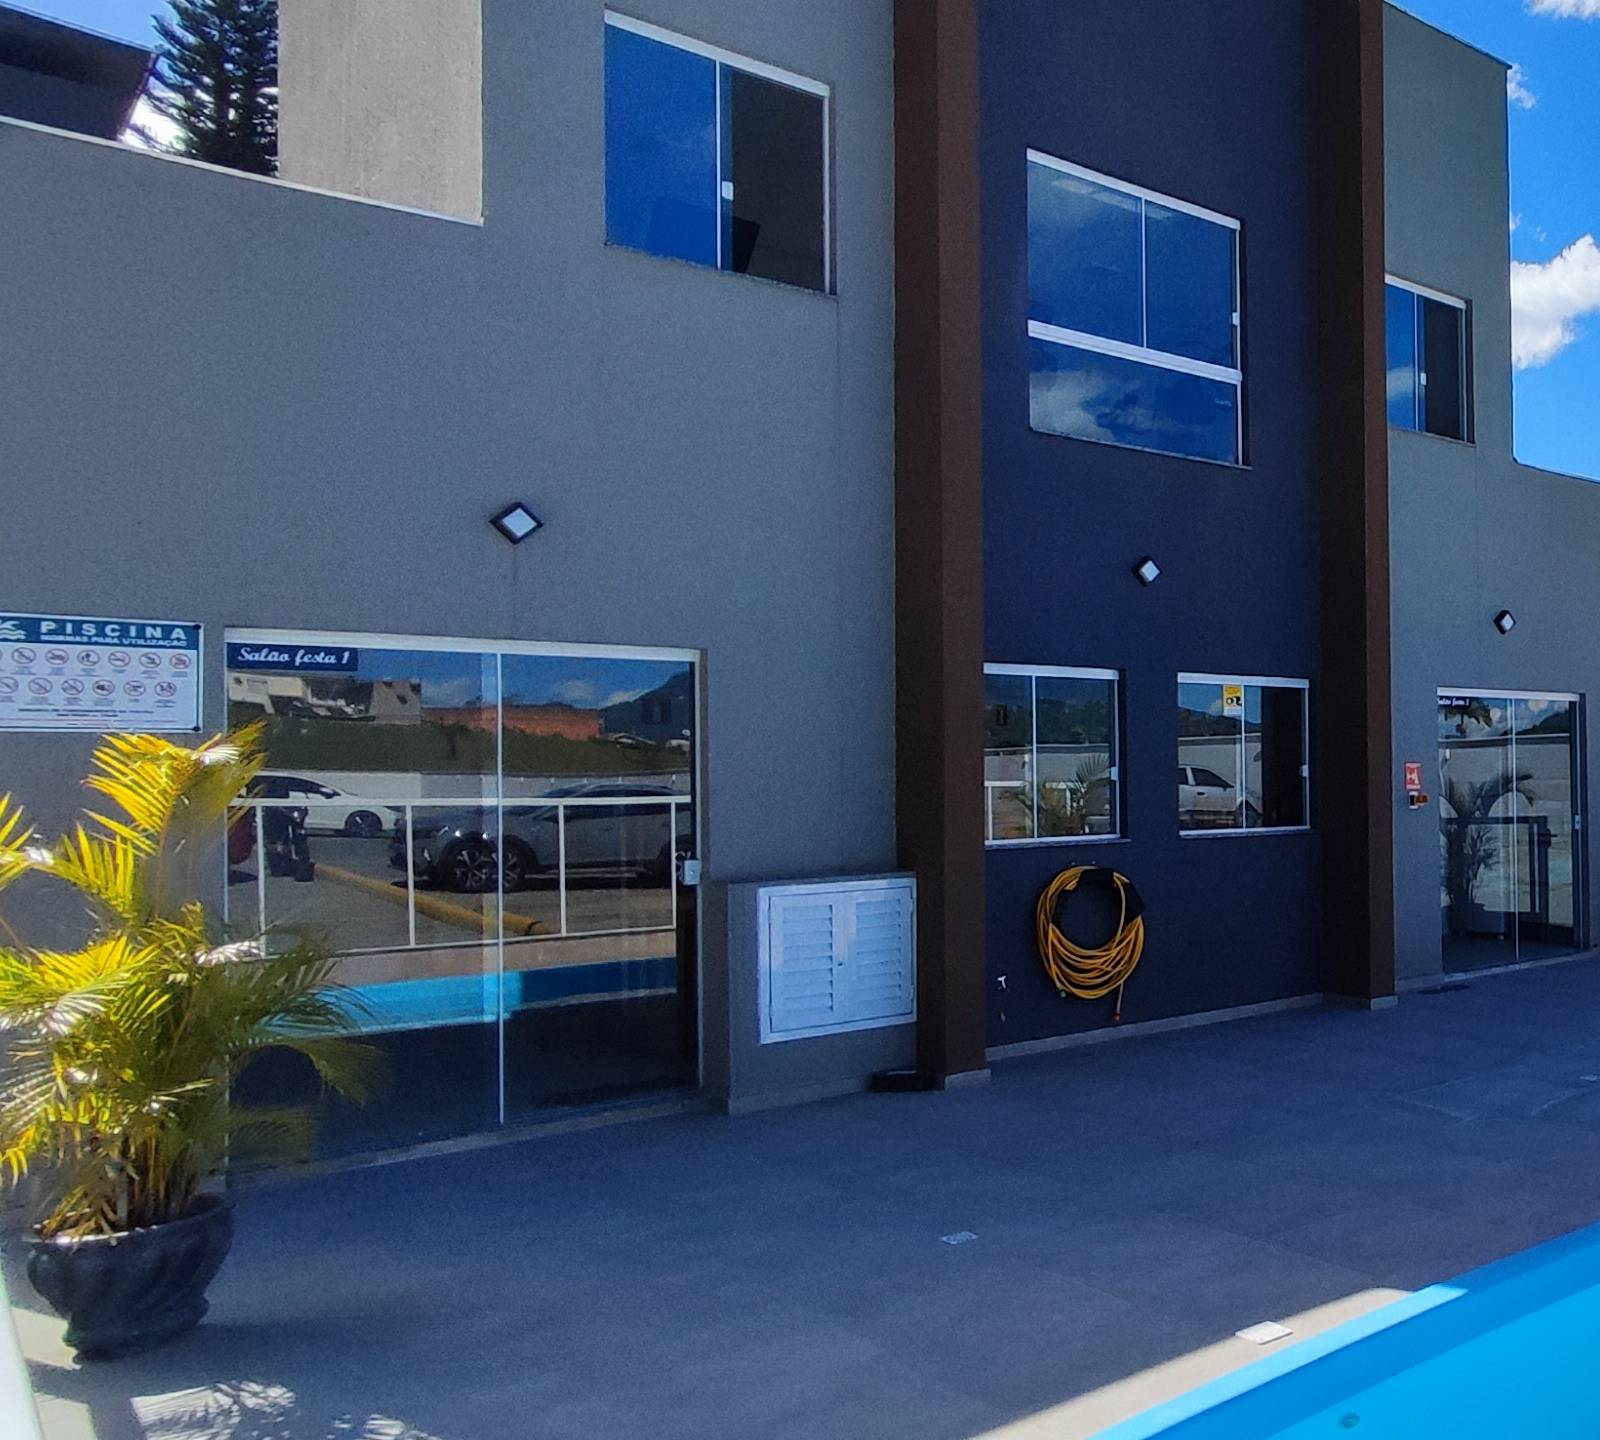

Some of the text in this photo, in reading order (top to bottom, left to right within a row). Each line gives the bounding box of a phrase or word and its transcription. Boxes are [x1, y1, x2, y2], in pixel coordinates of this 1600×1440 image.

[40, 621, 187, 639] PISCINA
[90, 636, 119, 644] PARA
[237, 647, 350, 666] Salão festa 1
